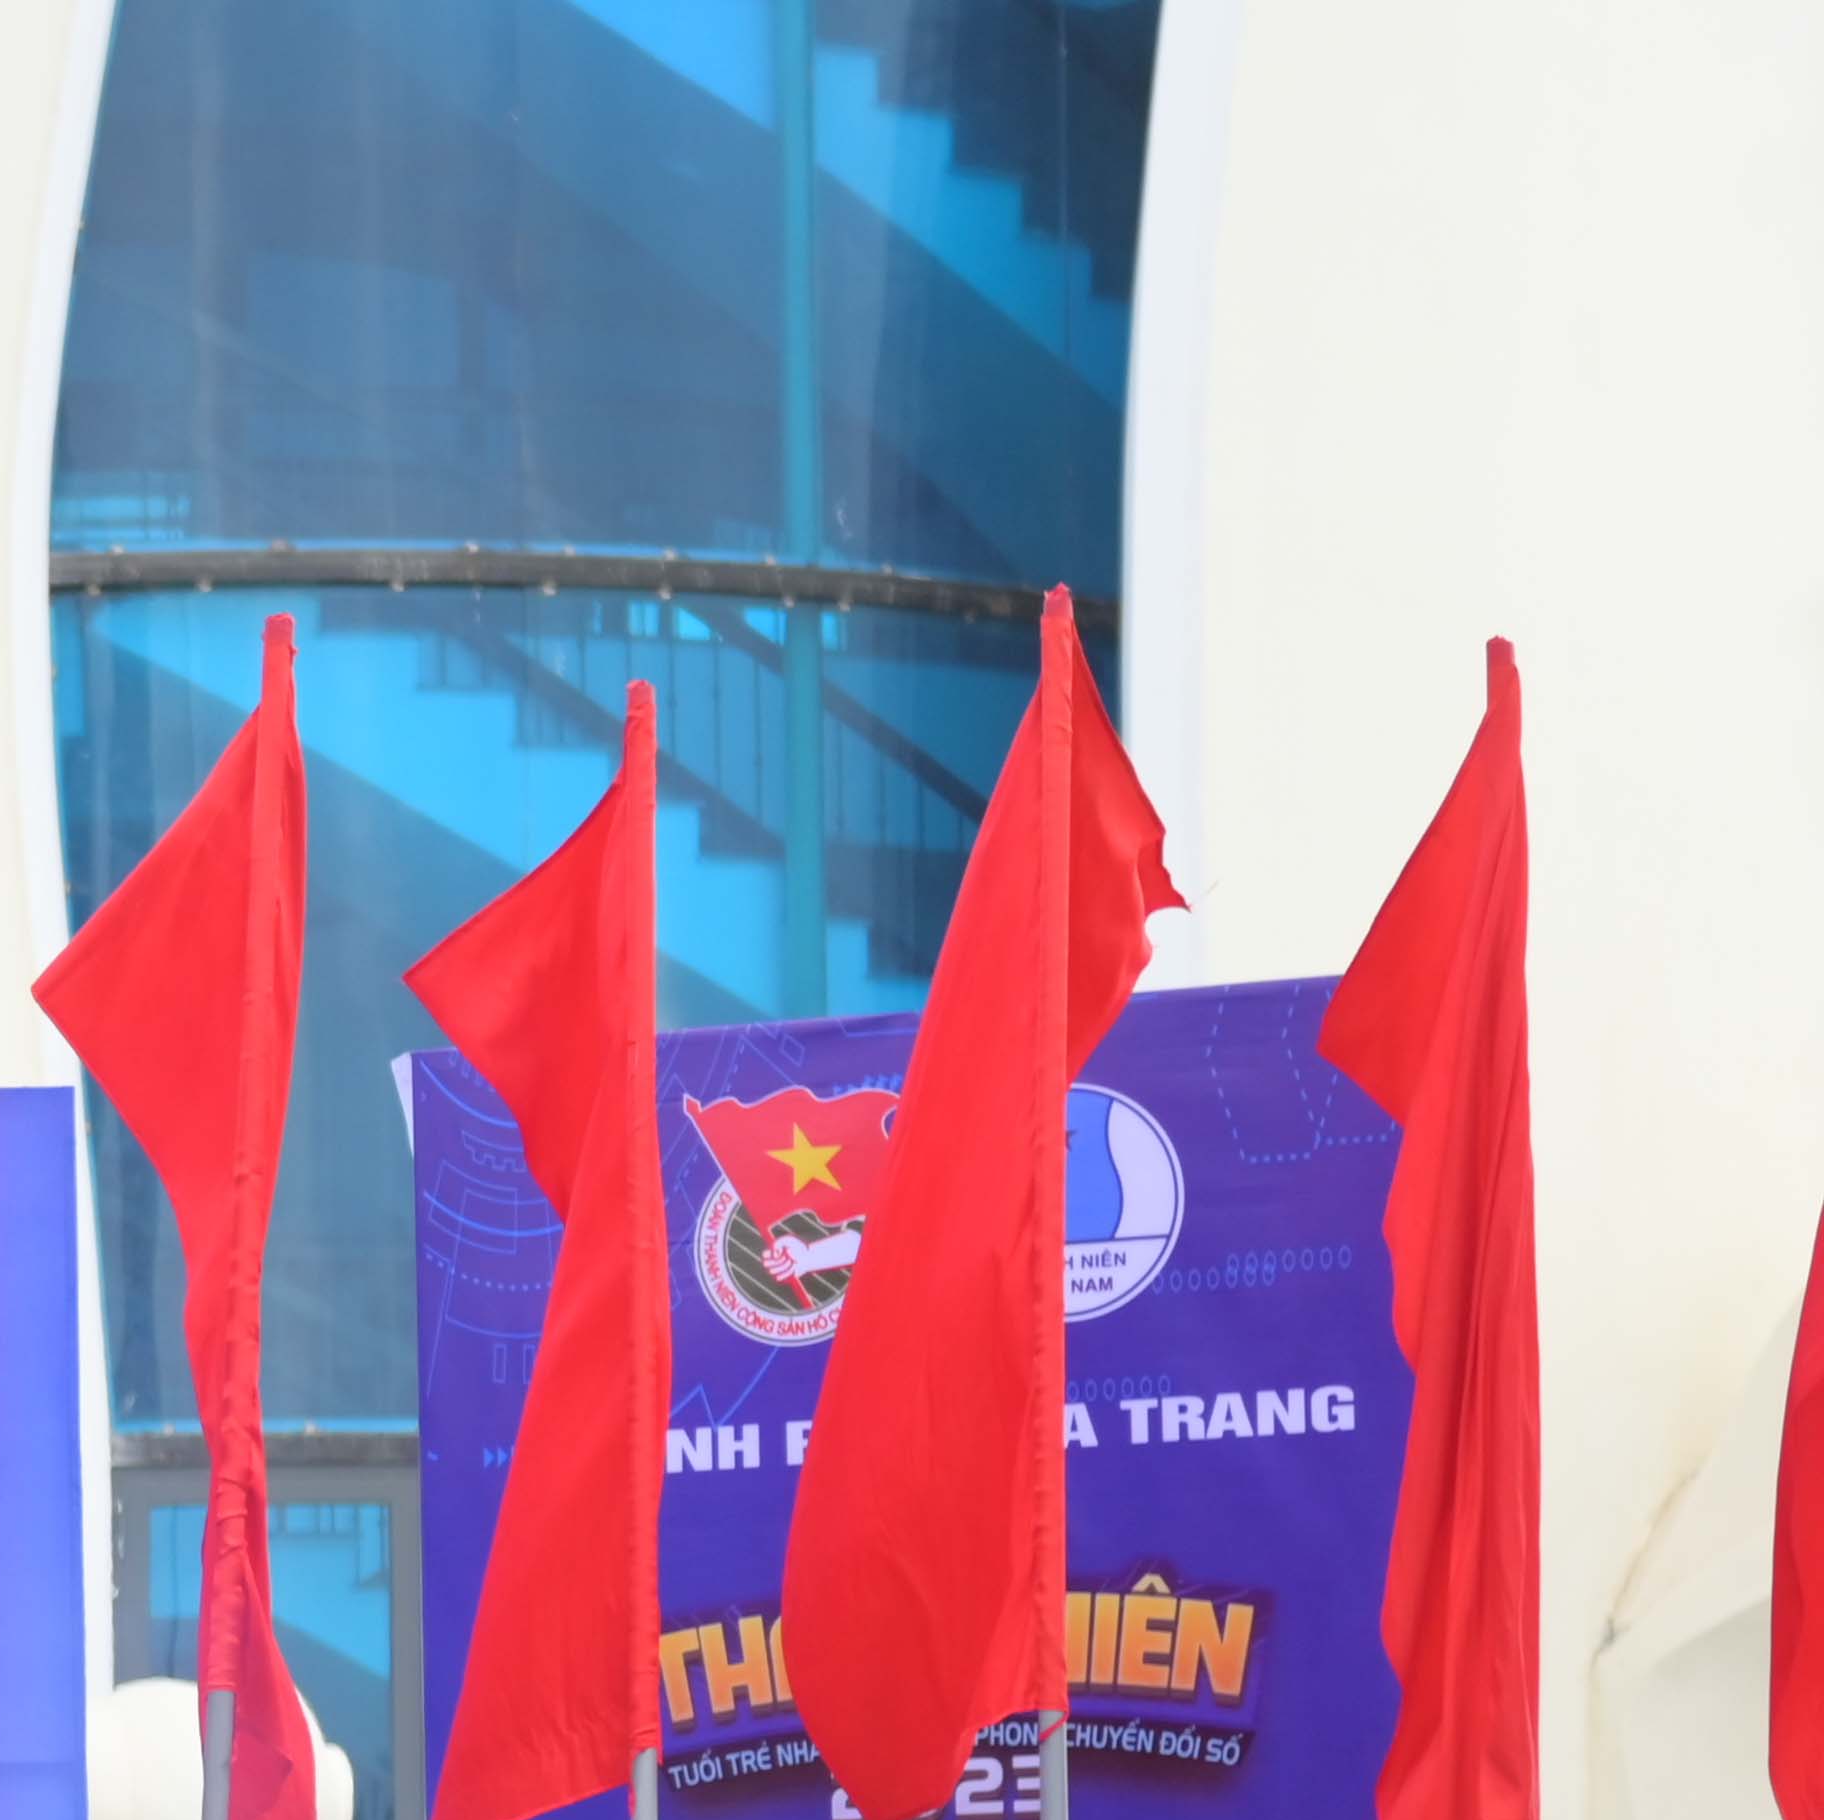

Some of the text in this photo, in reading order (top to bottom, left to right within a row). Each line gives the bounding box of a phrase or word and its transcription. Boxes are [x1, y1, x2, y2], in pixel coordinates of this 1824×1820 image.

[1080, 1248, 1127, 1269] NIÊN
[1071, 1277, 1113, 1294] NAM
[1120, 1384, 1356, 1446] TRANG
[1205, 1733, 1244, 1766] SỐ
